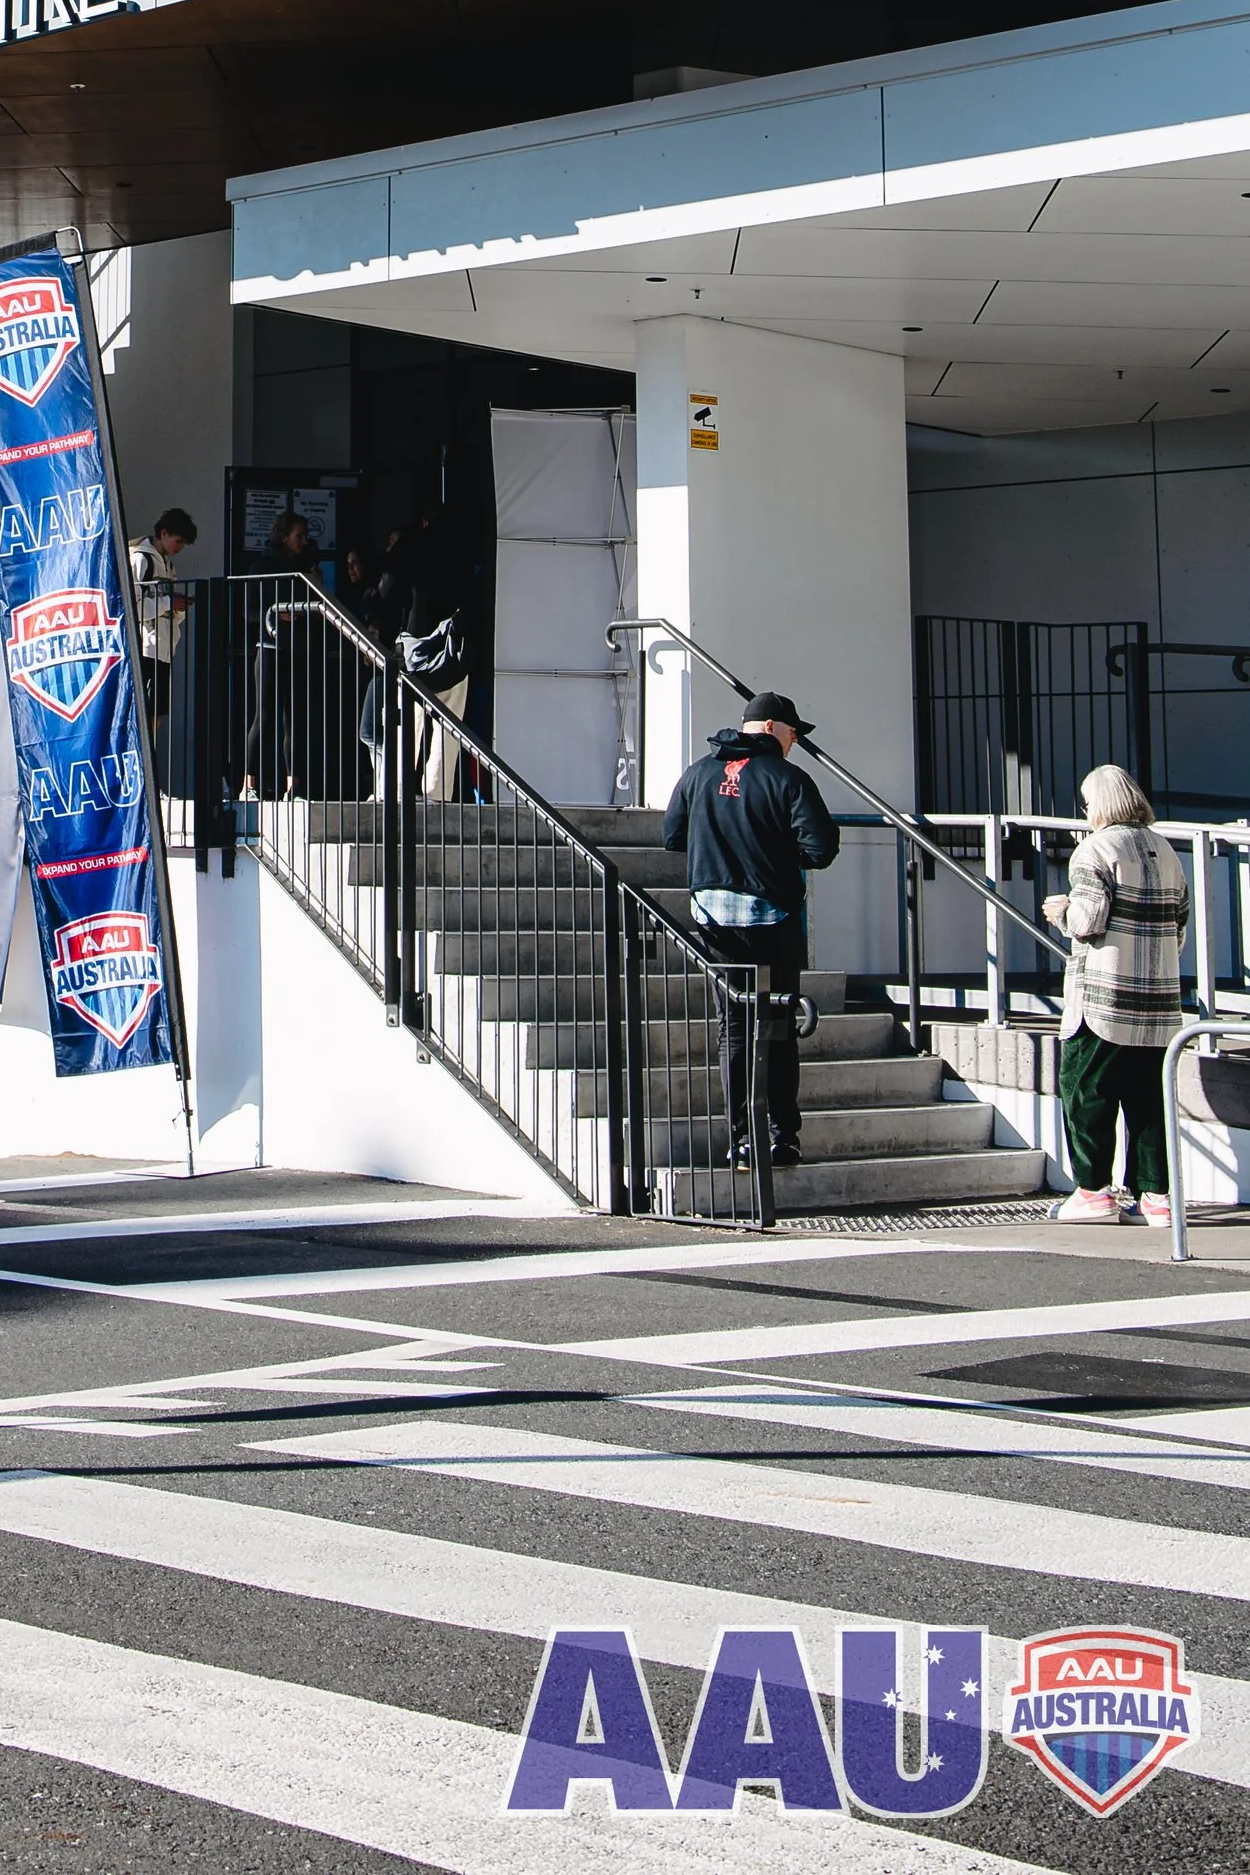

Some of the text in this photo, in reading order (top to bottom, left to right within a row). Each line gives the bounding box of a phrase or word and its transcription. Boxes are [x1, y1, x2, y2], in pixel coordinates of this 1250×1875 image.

[23, 444, 49, 456] YOUR
[49, 434, 90, 451] PATHWAY
[34, 603, 85, 633] AAU
[10, 628, 121, 674] AUSTRALIA
[29, 750, 142, 822] AAU
[42, 863, 77, 876] EXPAND
[79, 858, 105, 869] YOUR
[80, 933, 130, 954] AAU
[56, 956, 160, 997] AUSTRALIA
